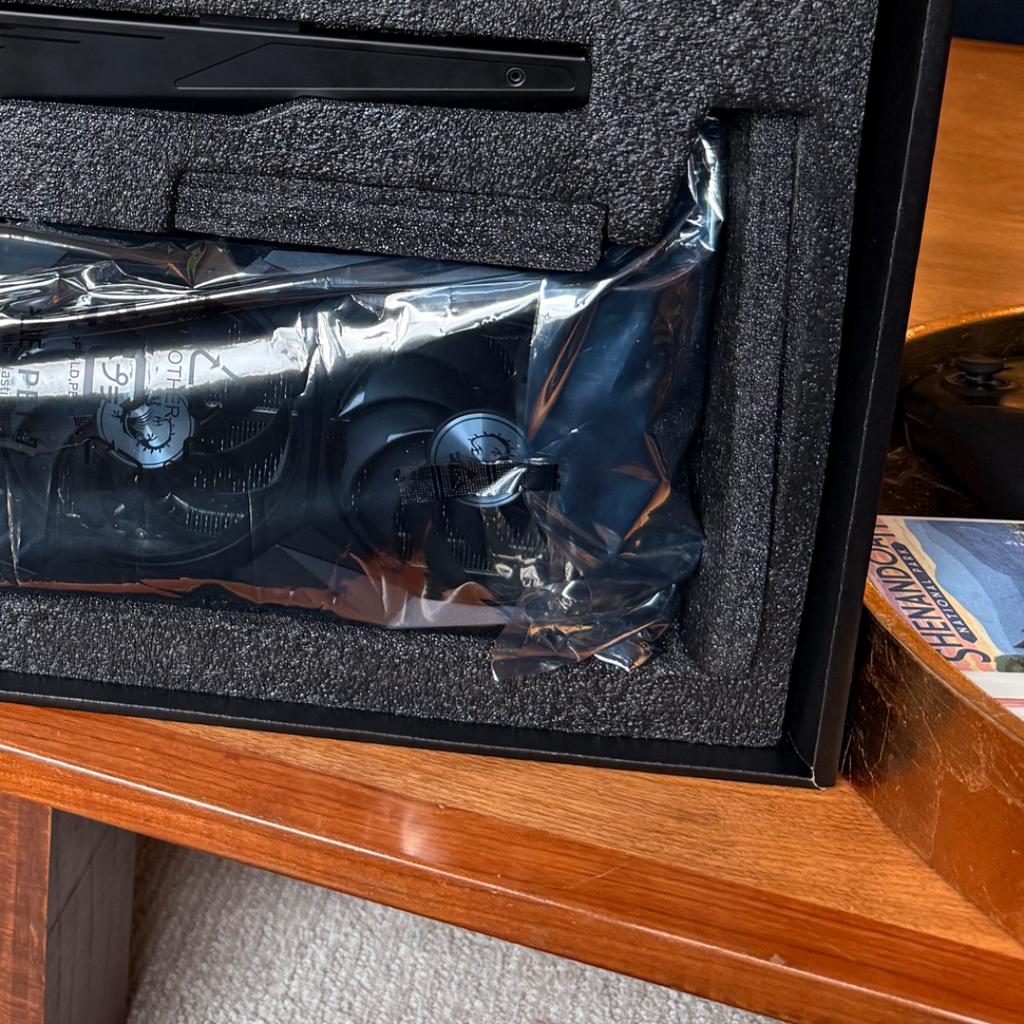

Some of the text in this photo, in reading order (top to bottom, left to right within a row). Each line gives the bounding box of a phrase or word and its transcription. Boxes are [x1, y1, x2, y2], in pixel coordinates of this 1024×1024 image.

[870, 524, 991, 663] SHENANDOA
[897, 548, 970, 636] NATIONAL PARK
